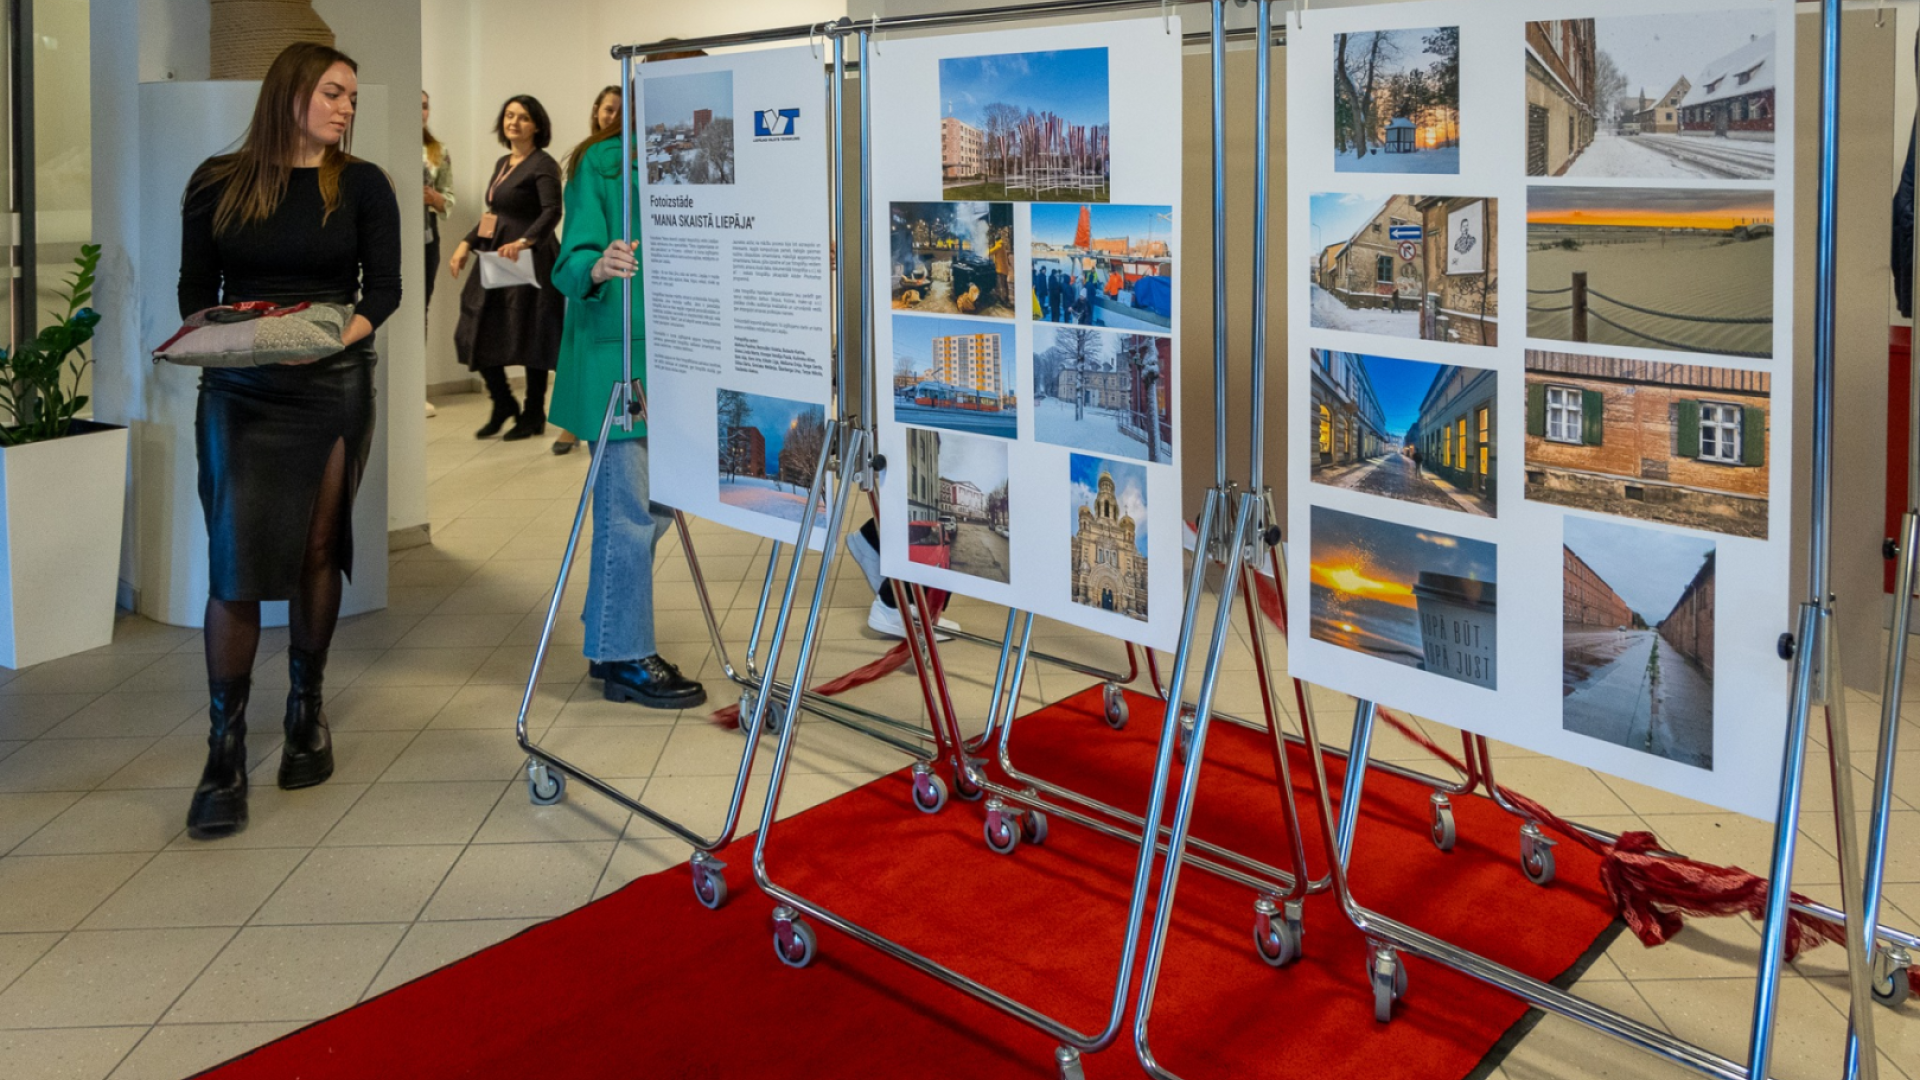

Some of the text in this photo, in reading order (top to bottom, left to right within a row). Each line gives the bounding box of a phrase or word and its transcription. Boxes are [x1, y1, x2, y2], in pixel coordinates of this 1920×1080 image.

[650, 194, 694, 208] Fotoizstāde
[678, 212, 714, 229] SKAISTĀ
[1456, 651, 1489, 681] JUST
